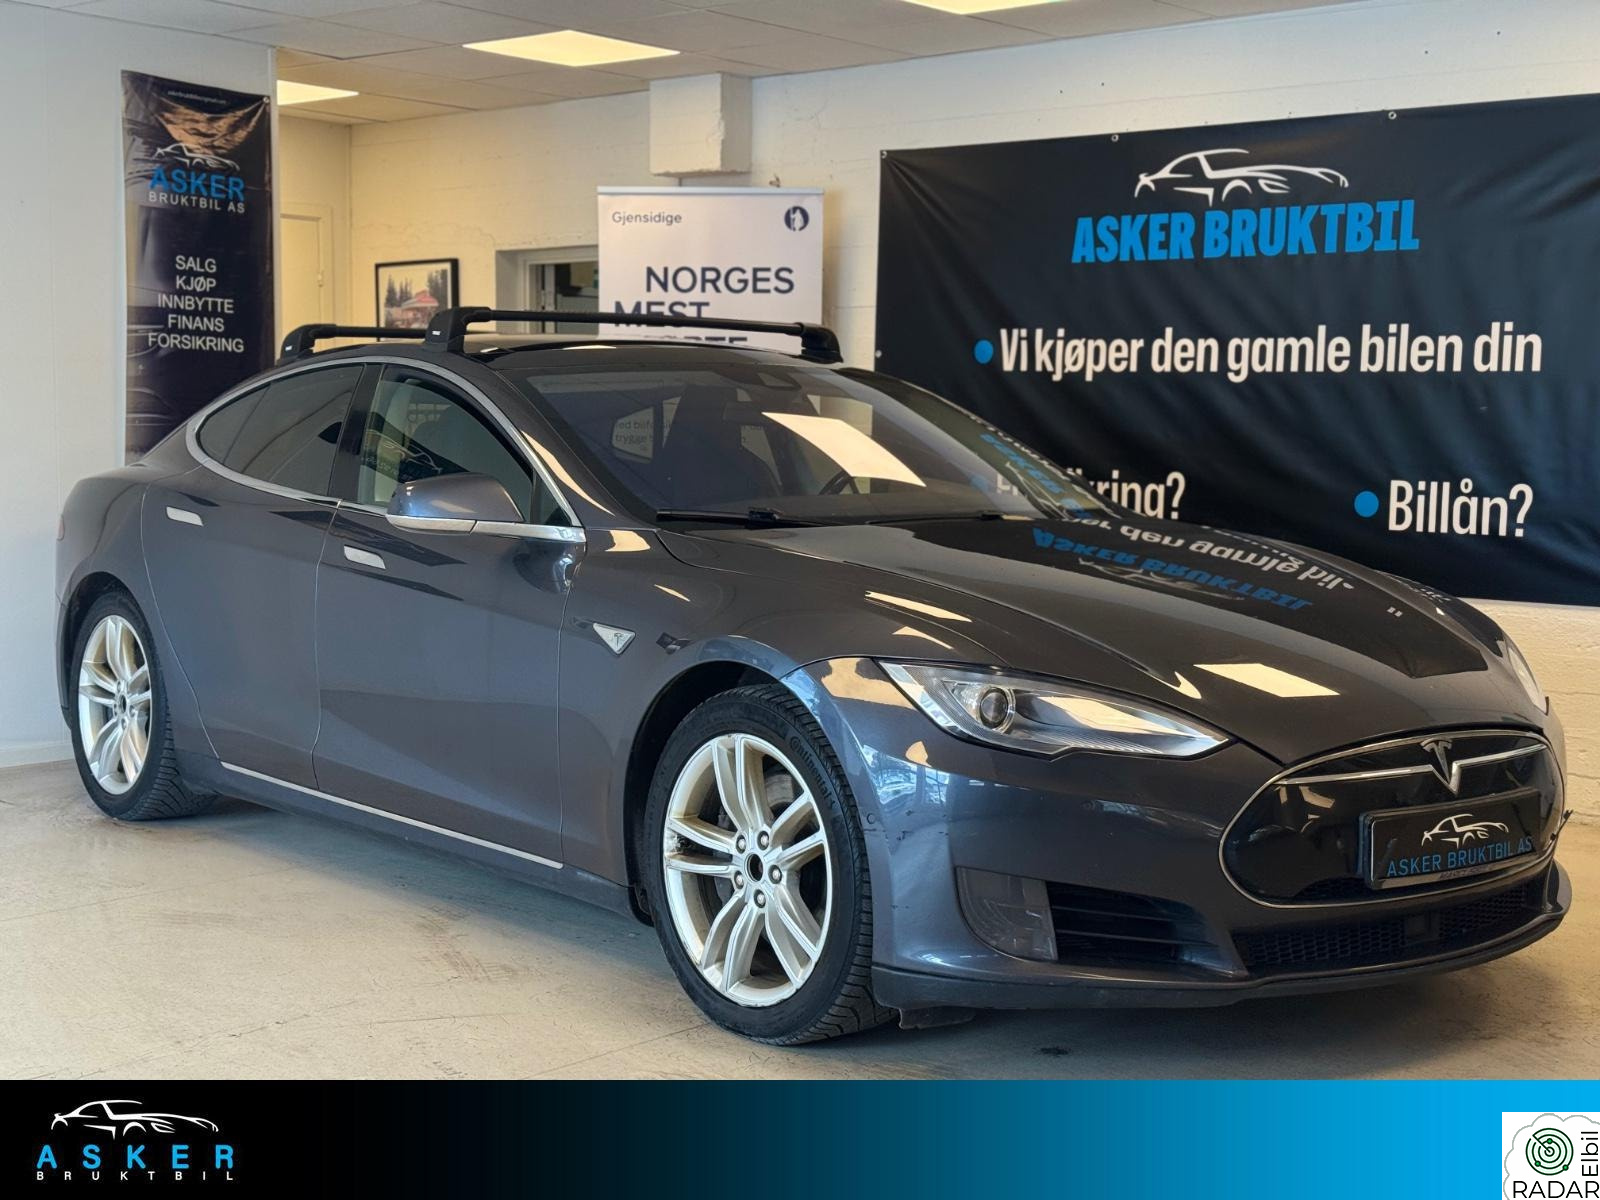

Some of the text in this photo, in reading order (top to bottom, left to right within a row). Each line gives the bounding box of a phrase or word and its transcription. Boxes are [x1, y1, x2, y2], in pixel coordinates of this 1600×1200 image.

[149, 165, 245, 202] ASKER
[149, 191, 245, 213] BRUKTBIL AS
[612, 212, 682, 226] Gjensidige
[1072, 198, 1421, 264] ASKER BRUKTBIL
[175, 254, 217, 273] SALG
[176, 275, 217, 292] KJØP
[646, 266, 795, 294] NORGES
[157, 293, 234, 314] INNBYTTE
[167, 314, 224, 332] FINANS
[147, 332, 245, 353] FORSIKRING
[1000, 321, 1543, 383] Vi kjøper den gamle bilen din
[1388, 477, 1534, 538] Billån?
[1386, 854, 1442, 877] ASKER
[1447, 840, 1514, 869] BRUKTBIL
[1517, 836, 1533, 853] AS
